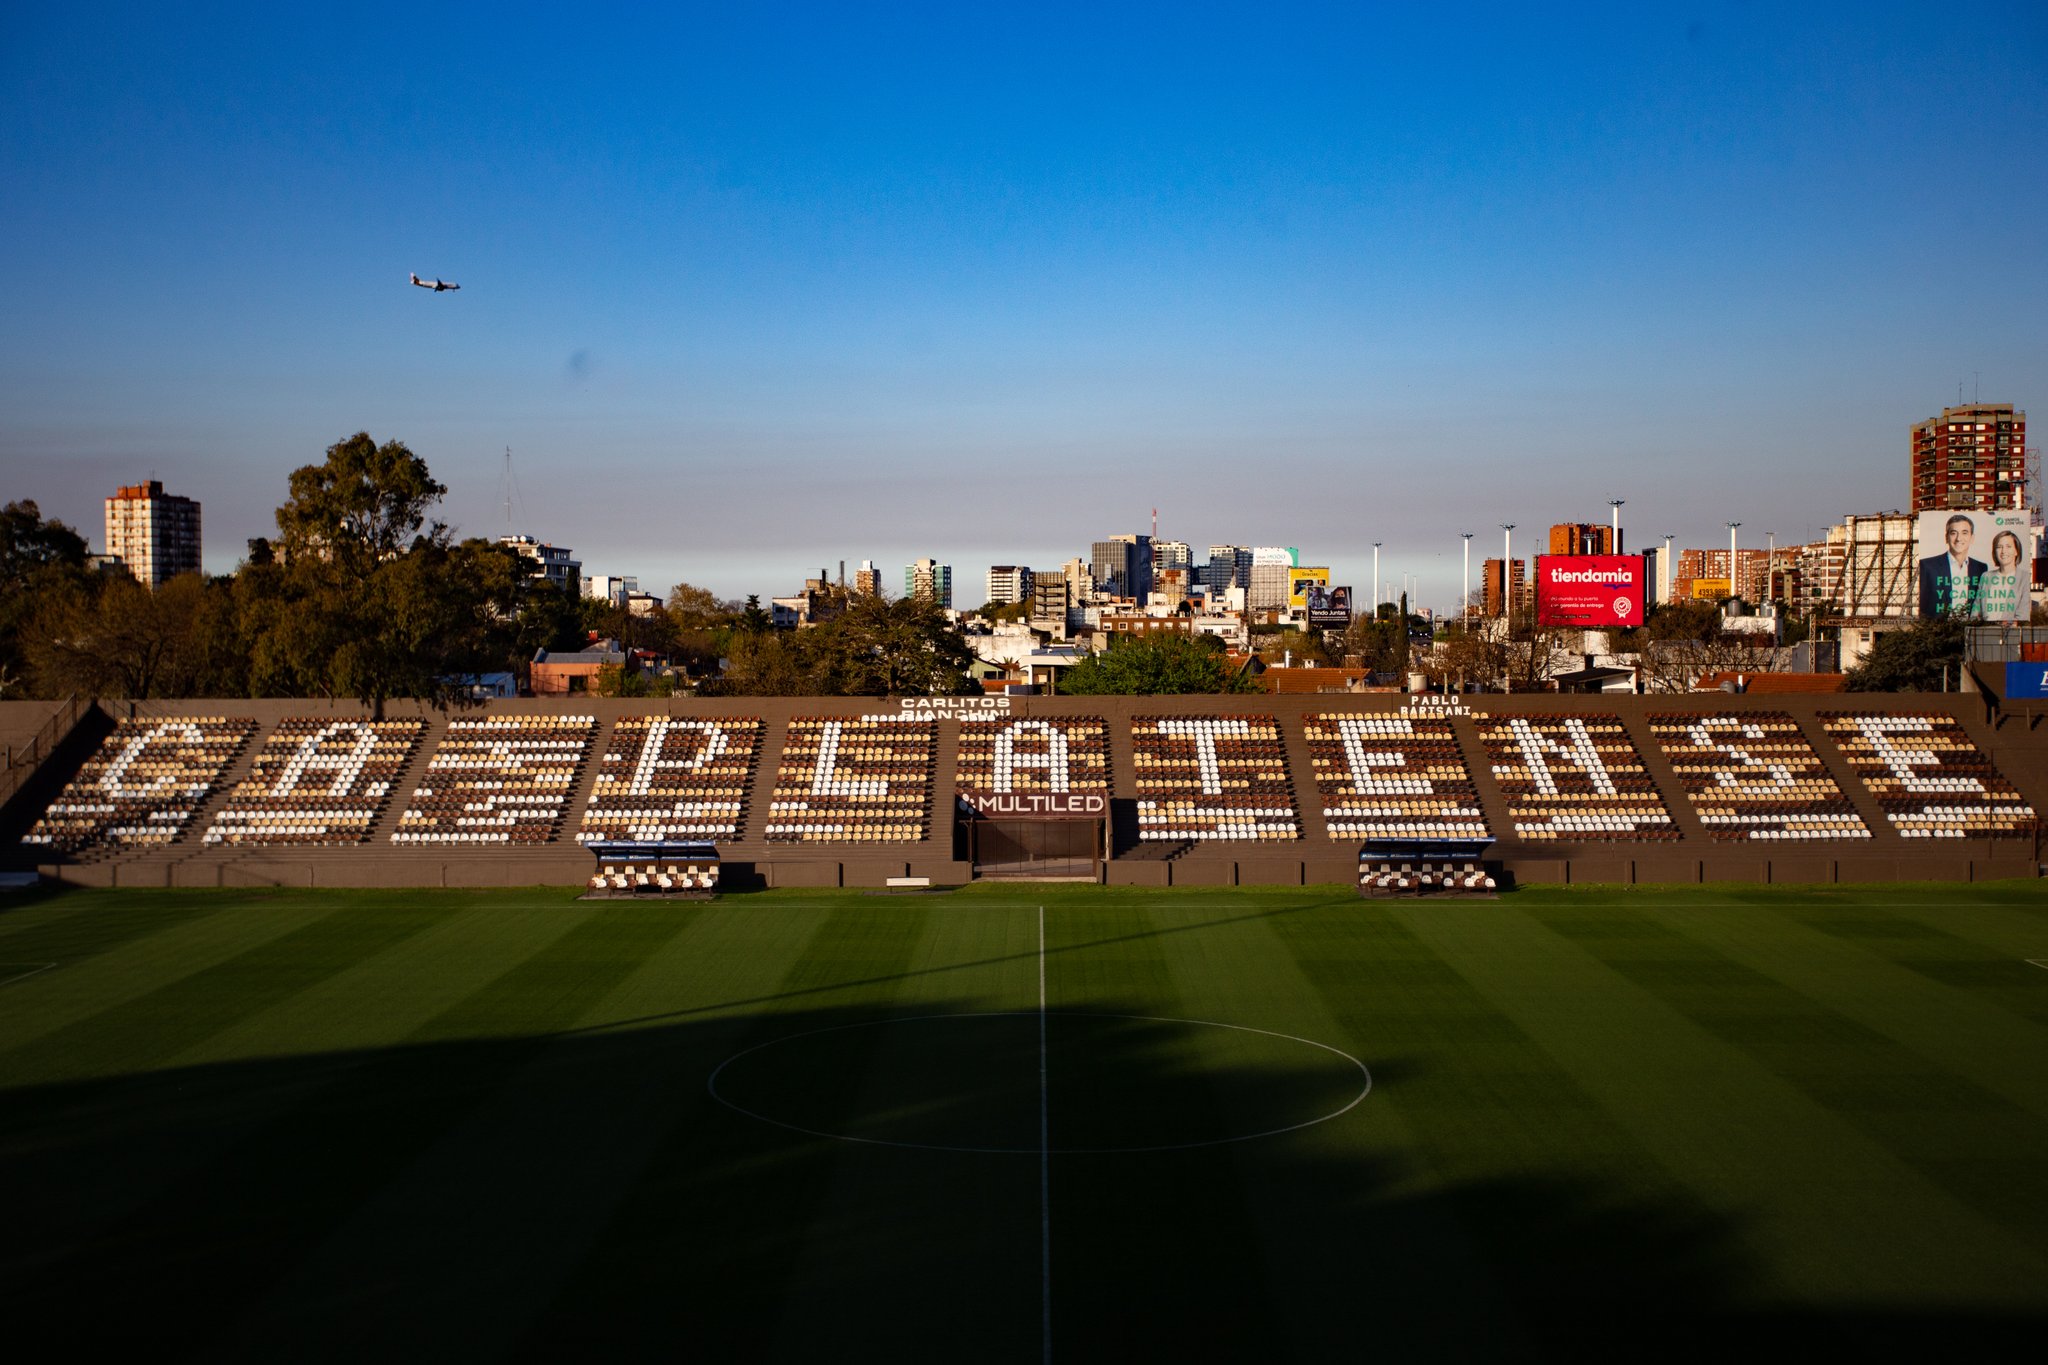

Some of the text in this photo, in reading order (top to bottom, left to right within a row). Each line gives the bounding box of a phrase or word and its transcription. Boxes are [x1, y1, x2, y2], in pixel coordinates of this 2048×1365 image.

[1551, 568, 1632, 582] tiendamia
[1936, 576, 2016, 586] FLORENCIO
[1936, 590, 2015, 599] Y CAROLINA
[1986, 603, 2015, 613] BIEN
[901, 698, 1010, 708] CARLITOS
[1411, 695, 1459, 705] PABLO
[1400, 706, 1471, 716] BARISANI
[979, 796, 1104, 812] MULTILED
